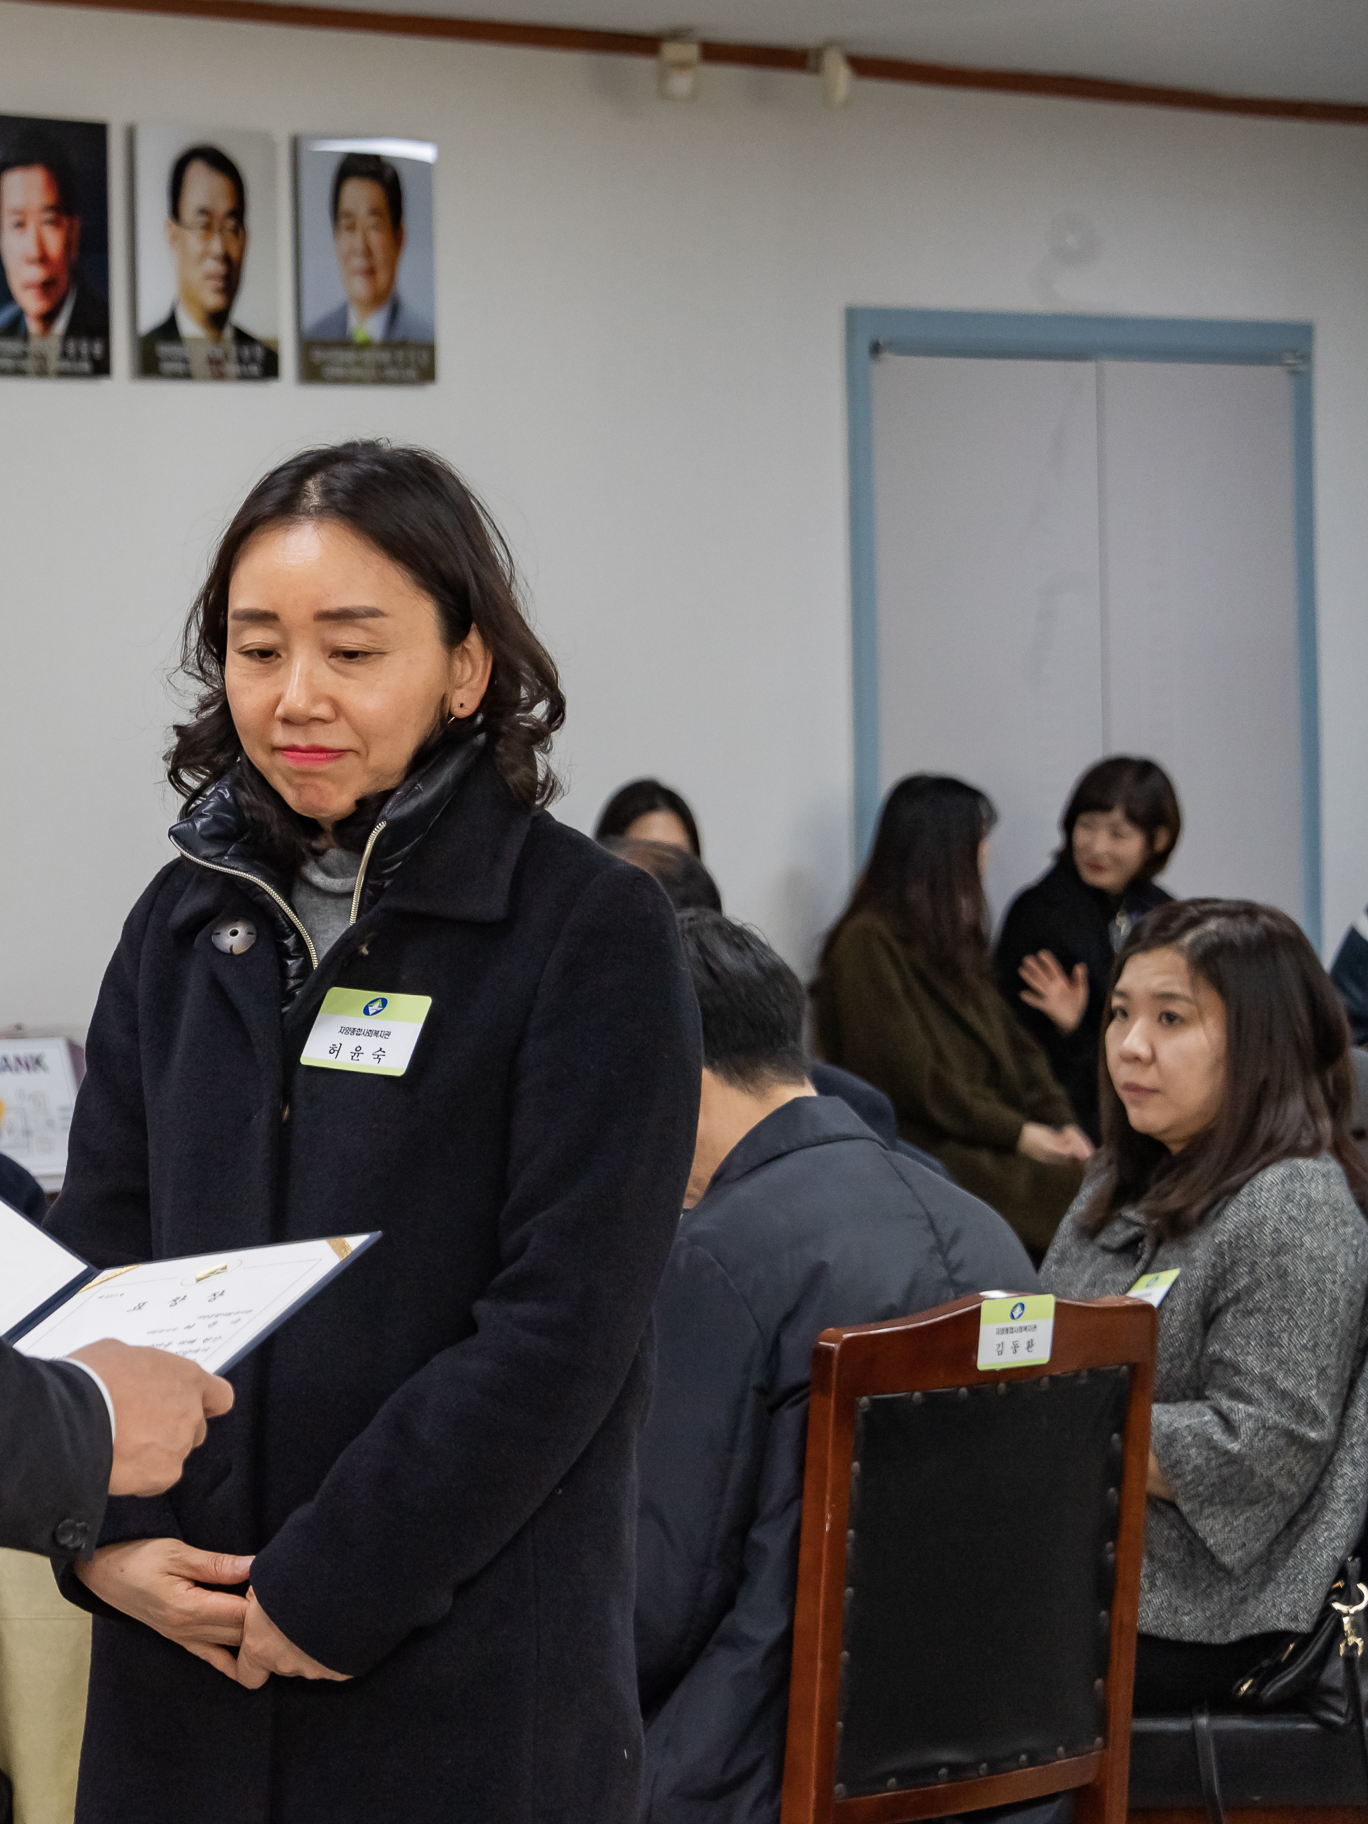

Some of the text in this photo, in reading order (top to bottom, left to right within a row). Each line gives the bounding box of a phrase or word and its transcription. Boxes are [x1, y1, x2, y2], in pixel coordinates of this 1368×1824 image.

[328, 1042, 386, 1064] 허 윤 숙
